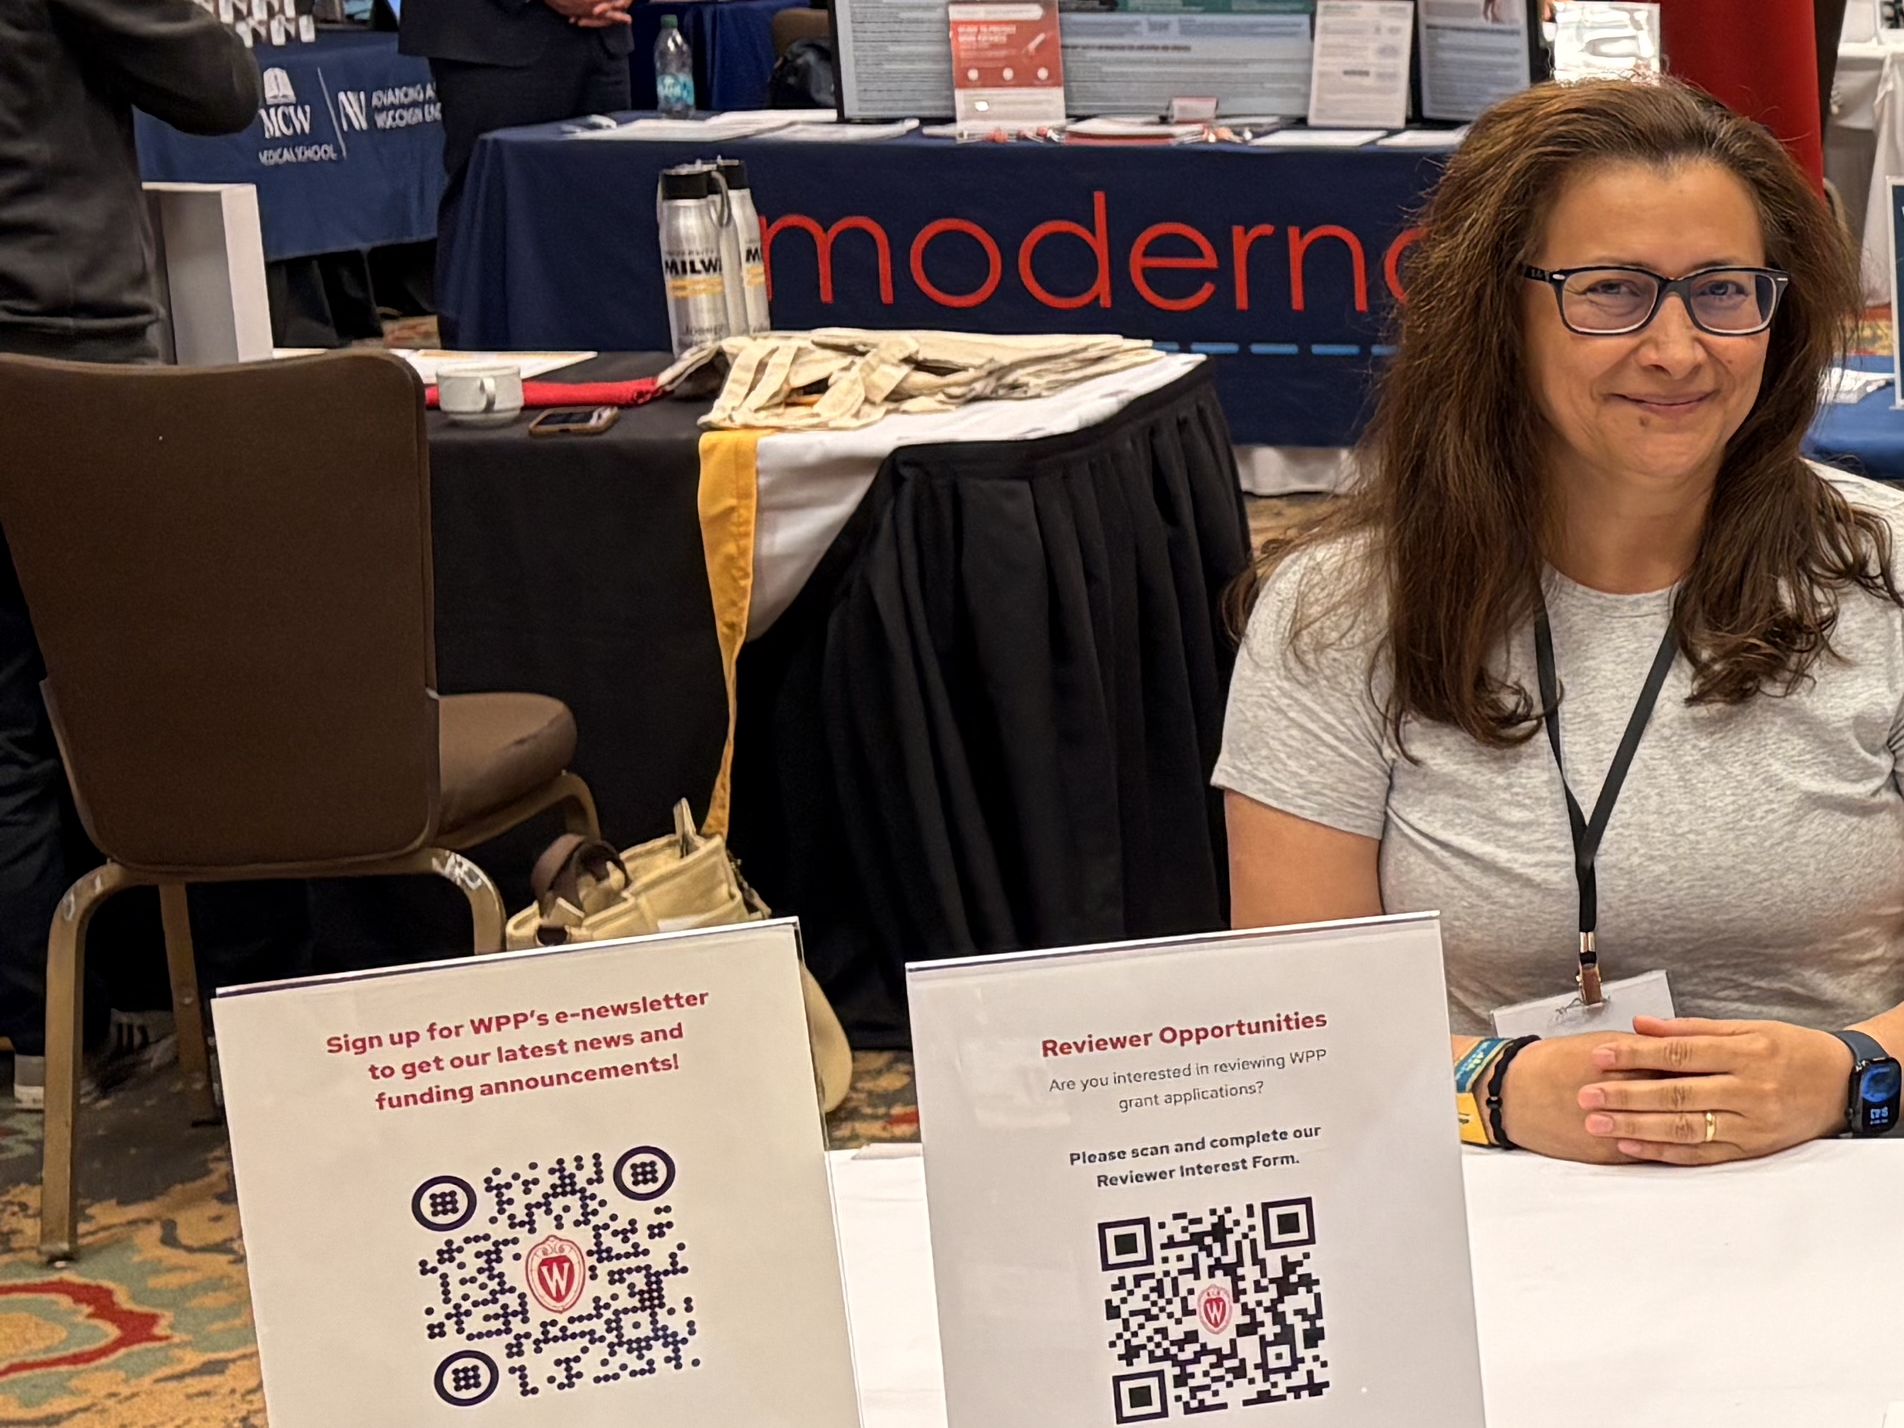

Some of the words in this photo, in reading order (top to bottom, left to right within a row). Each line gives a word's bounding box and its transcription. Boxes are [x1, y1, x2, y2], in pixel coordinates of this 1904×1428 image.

[259, 104, 311, 139] MCW
[326, 1033, 382, 1055] Sign
[389, 1030, 420, 1048] up
[426, 1022, 464, 1040] for
[470, 1010, 548, 1034] WPP's
[555, 992, 708, 1023] e-newsletter
[1042, 1032, 1152, 1057] Reviewer
[1159, 1011, 1326, 1046] Opportunities
[368, 1064, 394, 1079] to
[401, 1056, 444, 1079] get
[450, 1052, 490, 1068] our
[497, 1039, 568, 1063] latest
[574, 1033, 634, 1052] news
[640, 1022, 682, 1043] and
[375, 1085, 473, 1110] funding
[480, 1053, 678, 1095] announcements!
[1049, 1079, 1075, 1091] Are
[1080, 1077, 1108, 1092] you
[1113, 1063, 1191, 1084] interested
[1196, 1063, 1208, 1075] in
[1214, 1056, 1285, 1072] reviewing
[1290, 1049, 1326, 1063] WPP
[1119, 1094, 1159, 1112] grant
[1164, 1080, 1263, 1105] applications?
[1069, 1150, 1126, 1165] Please
[1131, 1145, 1169, 1158] scan
[1174, 1136, 1205, 1152] and
[1210, 1129, 1287, 1148] complete
[1293, 1127, 1320, 1138] our
[1097, 1169, 1175, 1187] Reviewer
[1180, 1158, 1247, 1177] Interest
[1252, 1155, 1299, 1168] Form.
[539, 1263, 572, 1300] W
[1203, 1298, 1226, 1323] W
